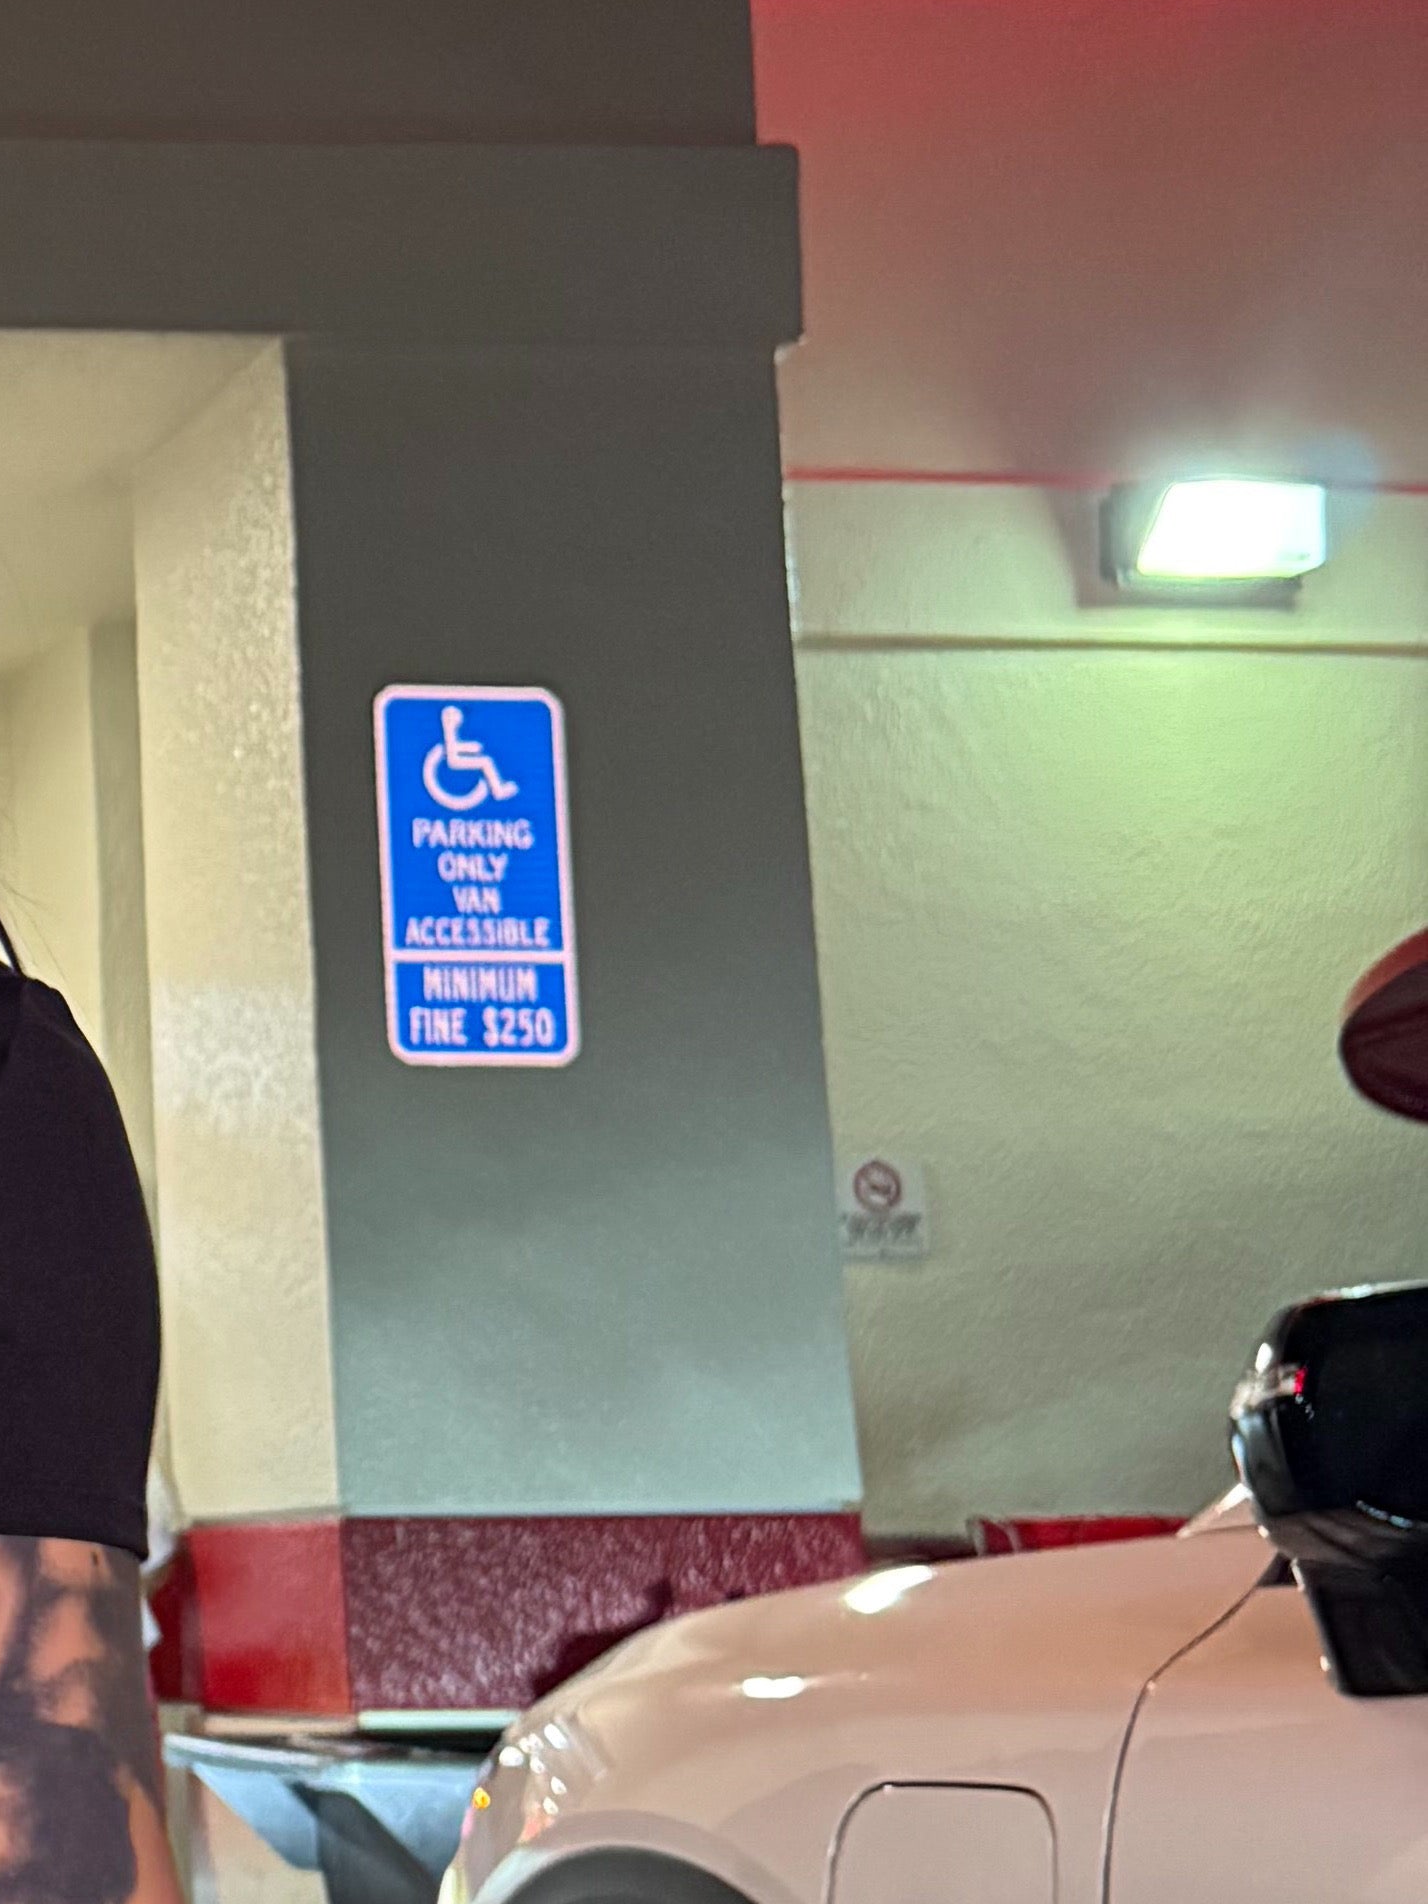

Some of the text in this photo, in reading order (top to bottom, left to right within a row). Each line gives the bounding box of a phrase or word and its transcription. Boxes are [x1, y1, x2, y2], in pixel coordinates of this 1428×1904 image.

[412, 817, 534, 849] PARKING
[437, 852, 508, 883] ONLY
[452, 886, 502, 914] VAN
[405, 917, 551, 947] ACCESSIBLE
[423, 965, 538, 1003] MINIMUM
[409, 1006, 555, 1048] FINE $250
